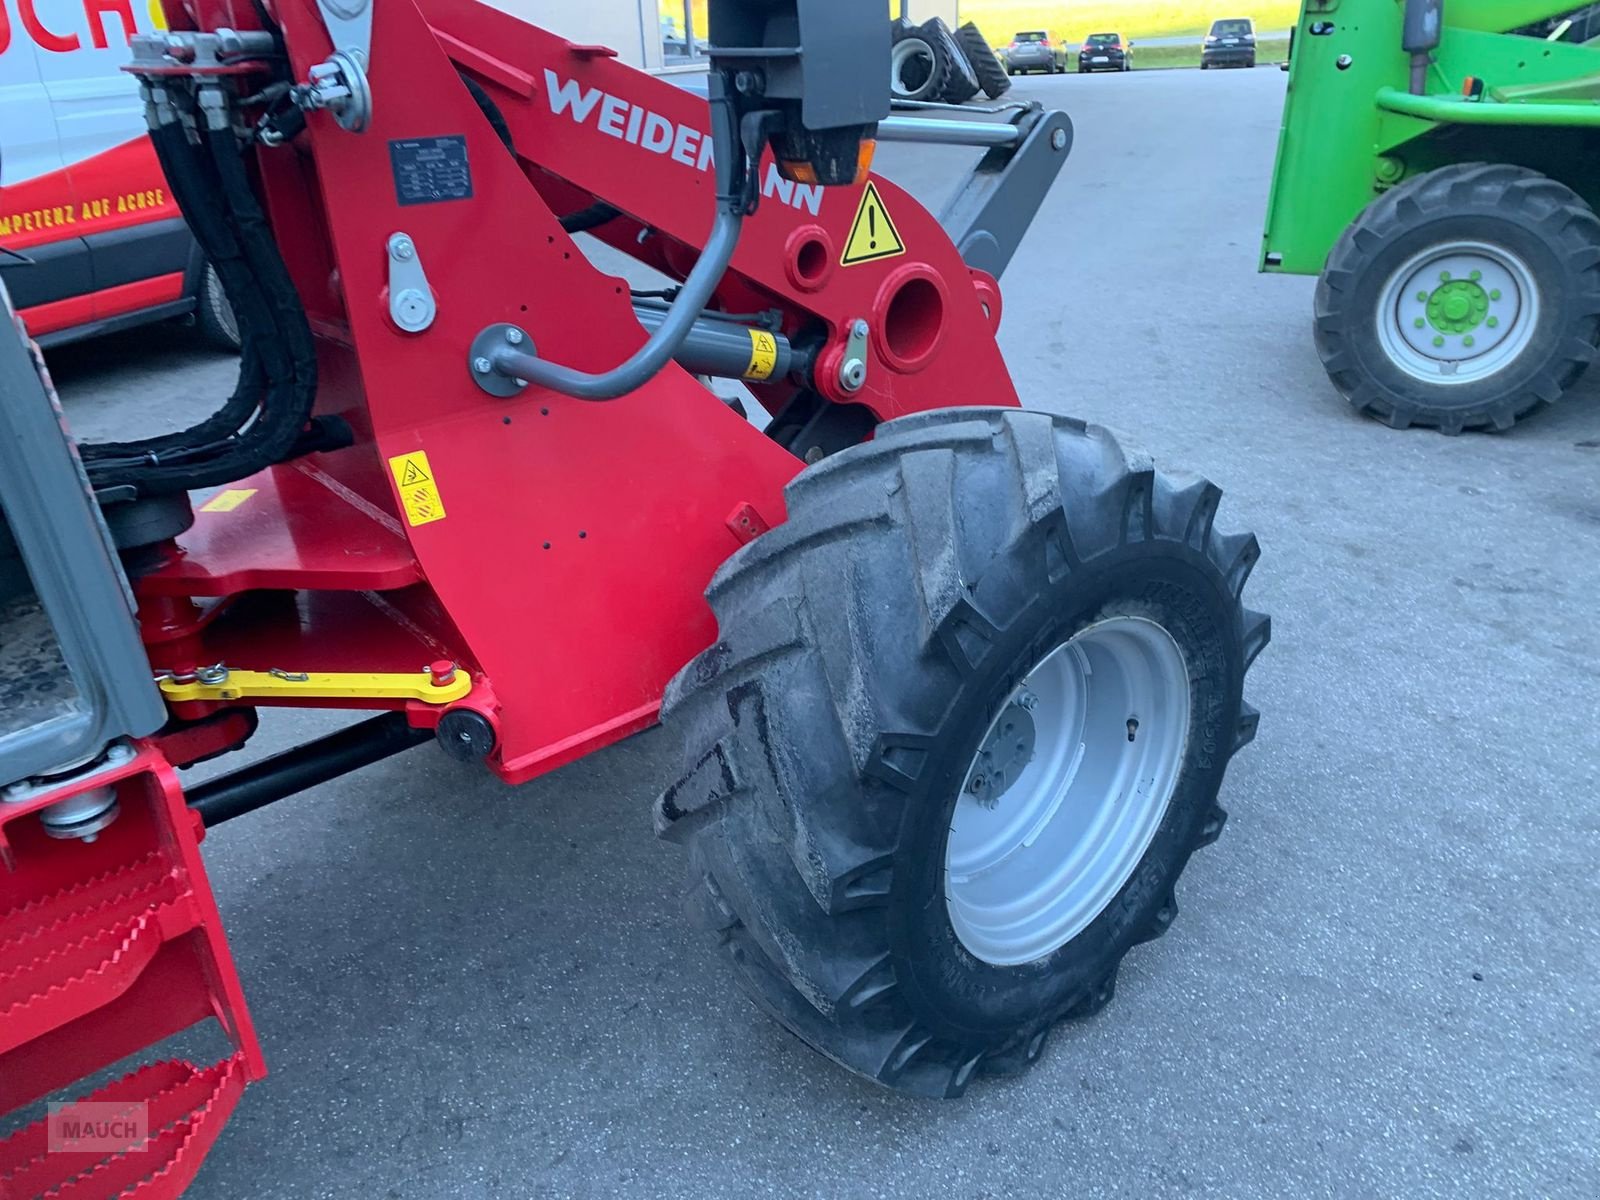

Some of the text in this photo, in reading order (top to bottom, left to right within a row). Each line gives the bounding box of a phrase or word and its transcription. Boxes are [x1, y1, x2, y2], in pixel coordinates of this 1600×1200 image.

[543, 68, 825, 217] WEIDENN
[82, 198, 110, 220] AUF
[117, 188, 164, 213] ACHSE
